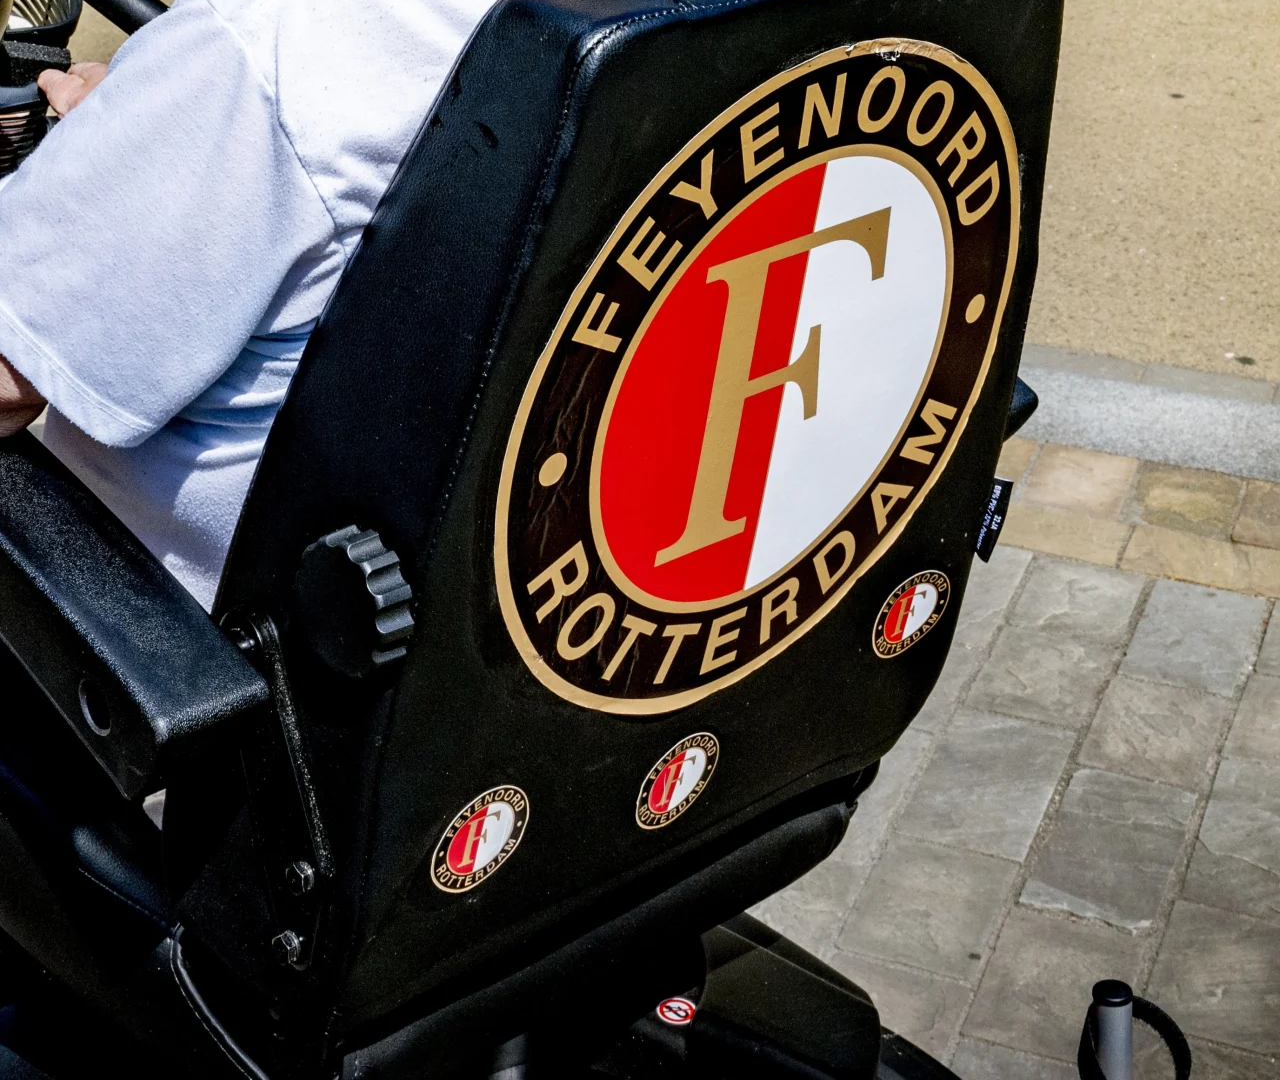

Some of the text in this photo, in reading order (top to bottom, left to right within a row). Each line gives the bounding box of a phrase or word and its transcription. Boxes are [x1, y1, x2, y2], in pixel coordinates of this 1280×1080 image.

[572, 67, 999, 353] FEYENOORD
[654, 206, 892, 568] F
[527, 399, 958, 685] ROTTERDAM
[883, 573, 947, 613] FEYENOORD
[890, 590, 927, 638] F
[876, 613, 939, 654] ROTTERDAM
[649, 736, 717, 780] FEYENOORD
[655, 755, 697, 808] F
[446, 789, 525, 838] FEYENOORD
[639, 780, 705, 825] ROTTERDAM
[436, 838, 516, 888] ROTTERDAM
[457, 809, 501, 868] F
